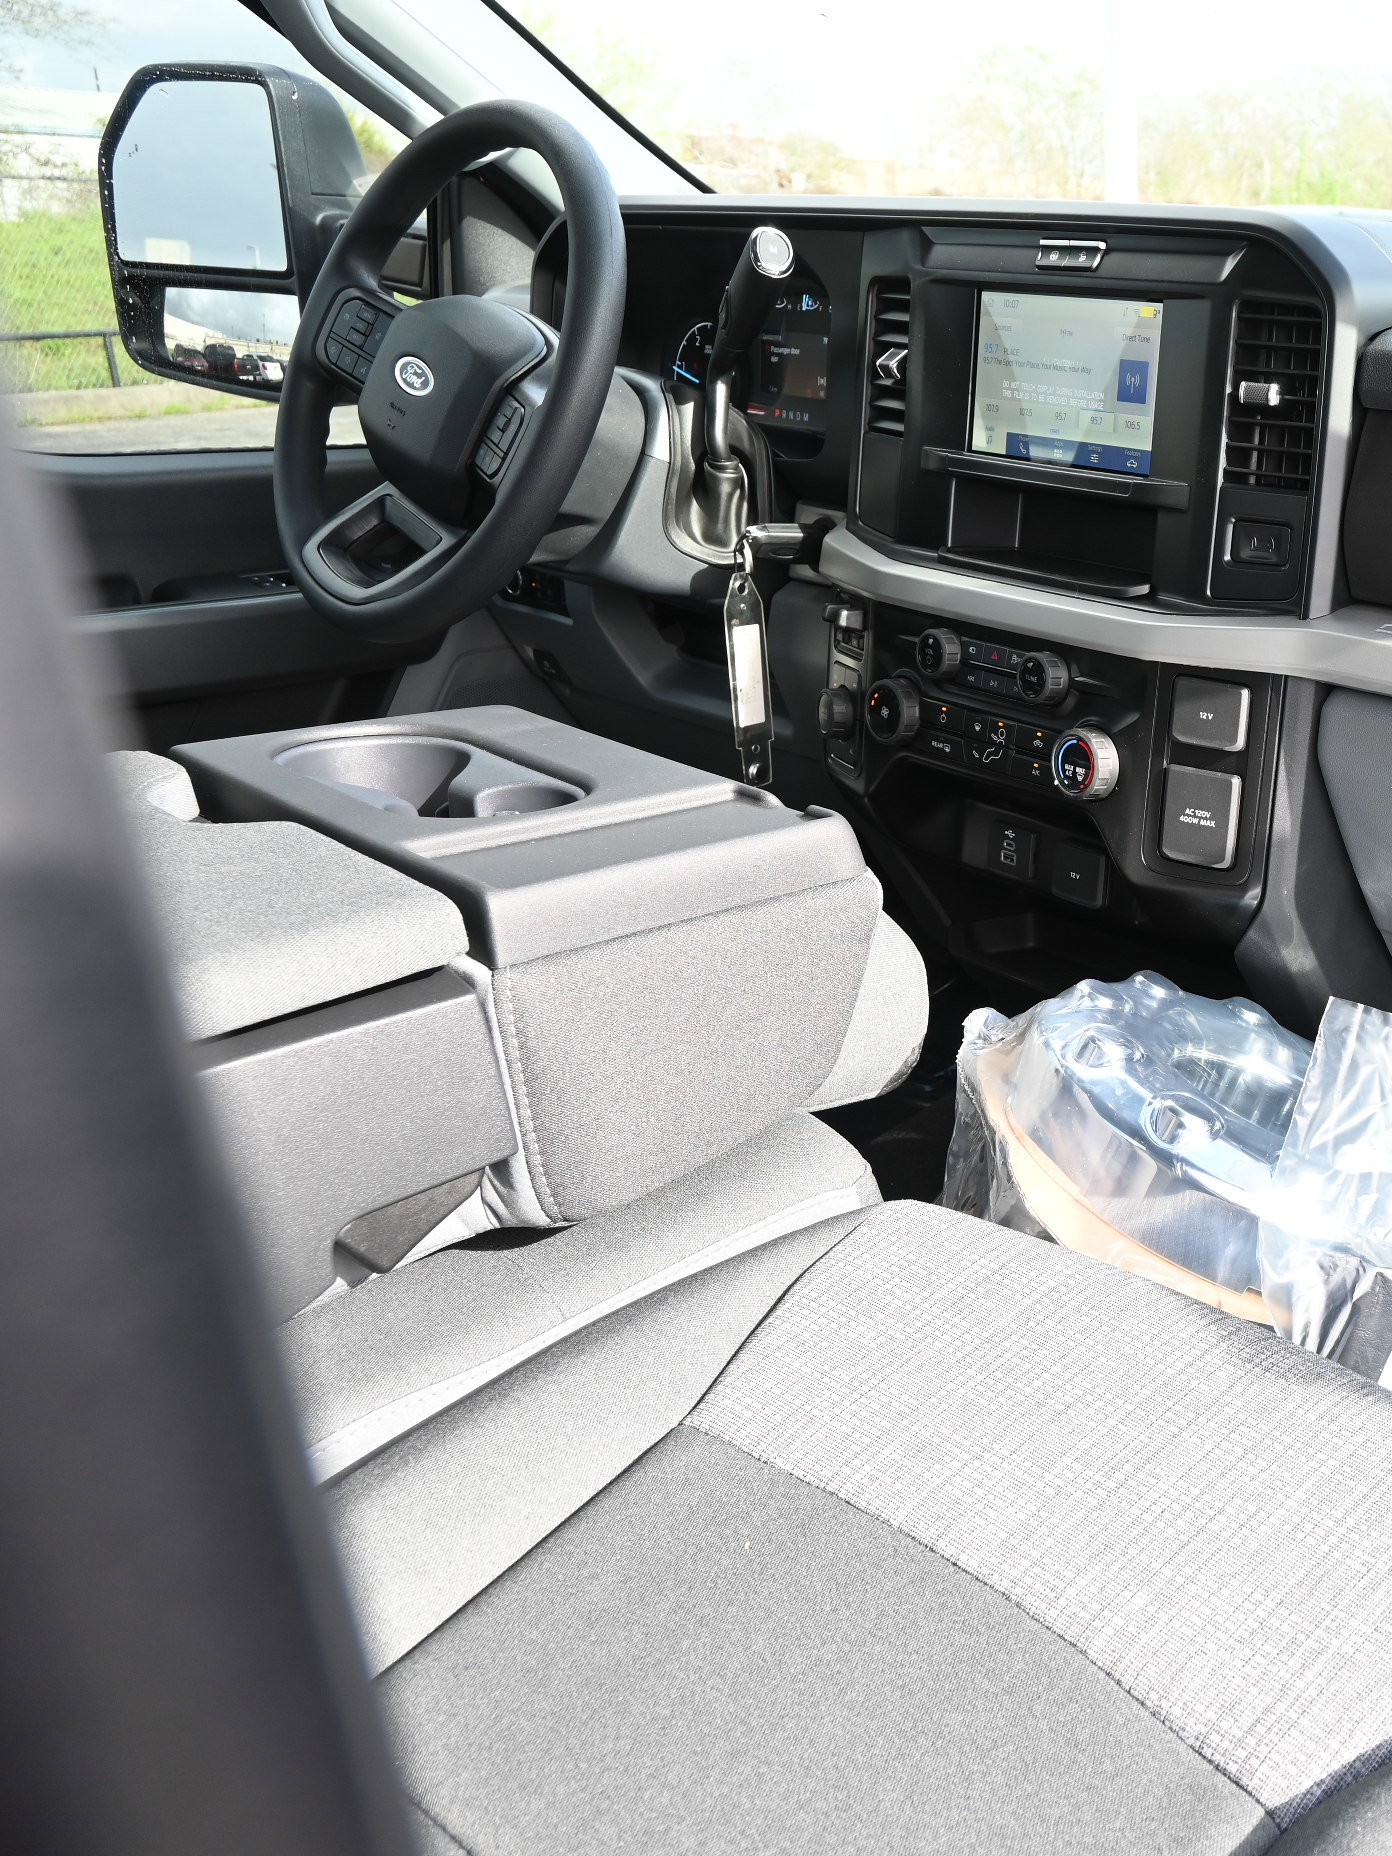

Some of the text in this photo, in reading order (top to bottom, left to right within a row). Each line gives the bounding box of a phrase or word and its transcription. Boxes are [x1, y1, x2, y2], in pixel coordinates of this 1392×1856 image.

[1003, 299, 1019, 308] 10:07
[1122, 334, 1151, 343] Direct Tune
[984, 343, 999, 353] 95.7
[994, 357, 1003, 365] The
[1054, 412, 1067, 420] 95.7
[1025, 674, 1038, 683] TUNE
[1195, 810, 1211, 818] 120V
[1180, 815, 1215, 827] 400W MAX
